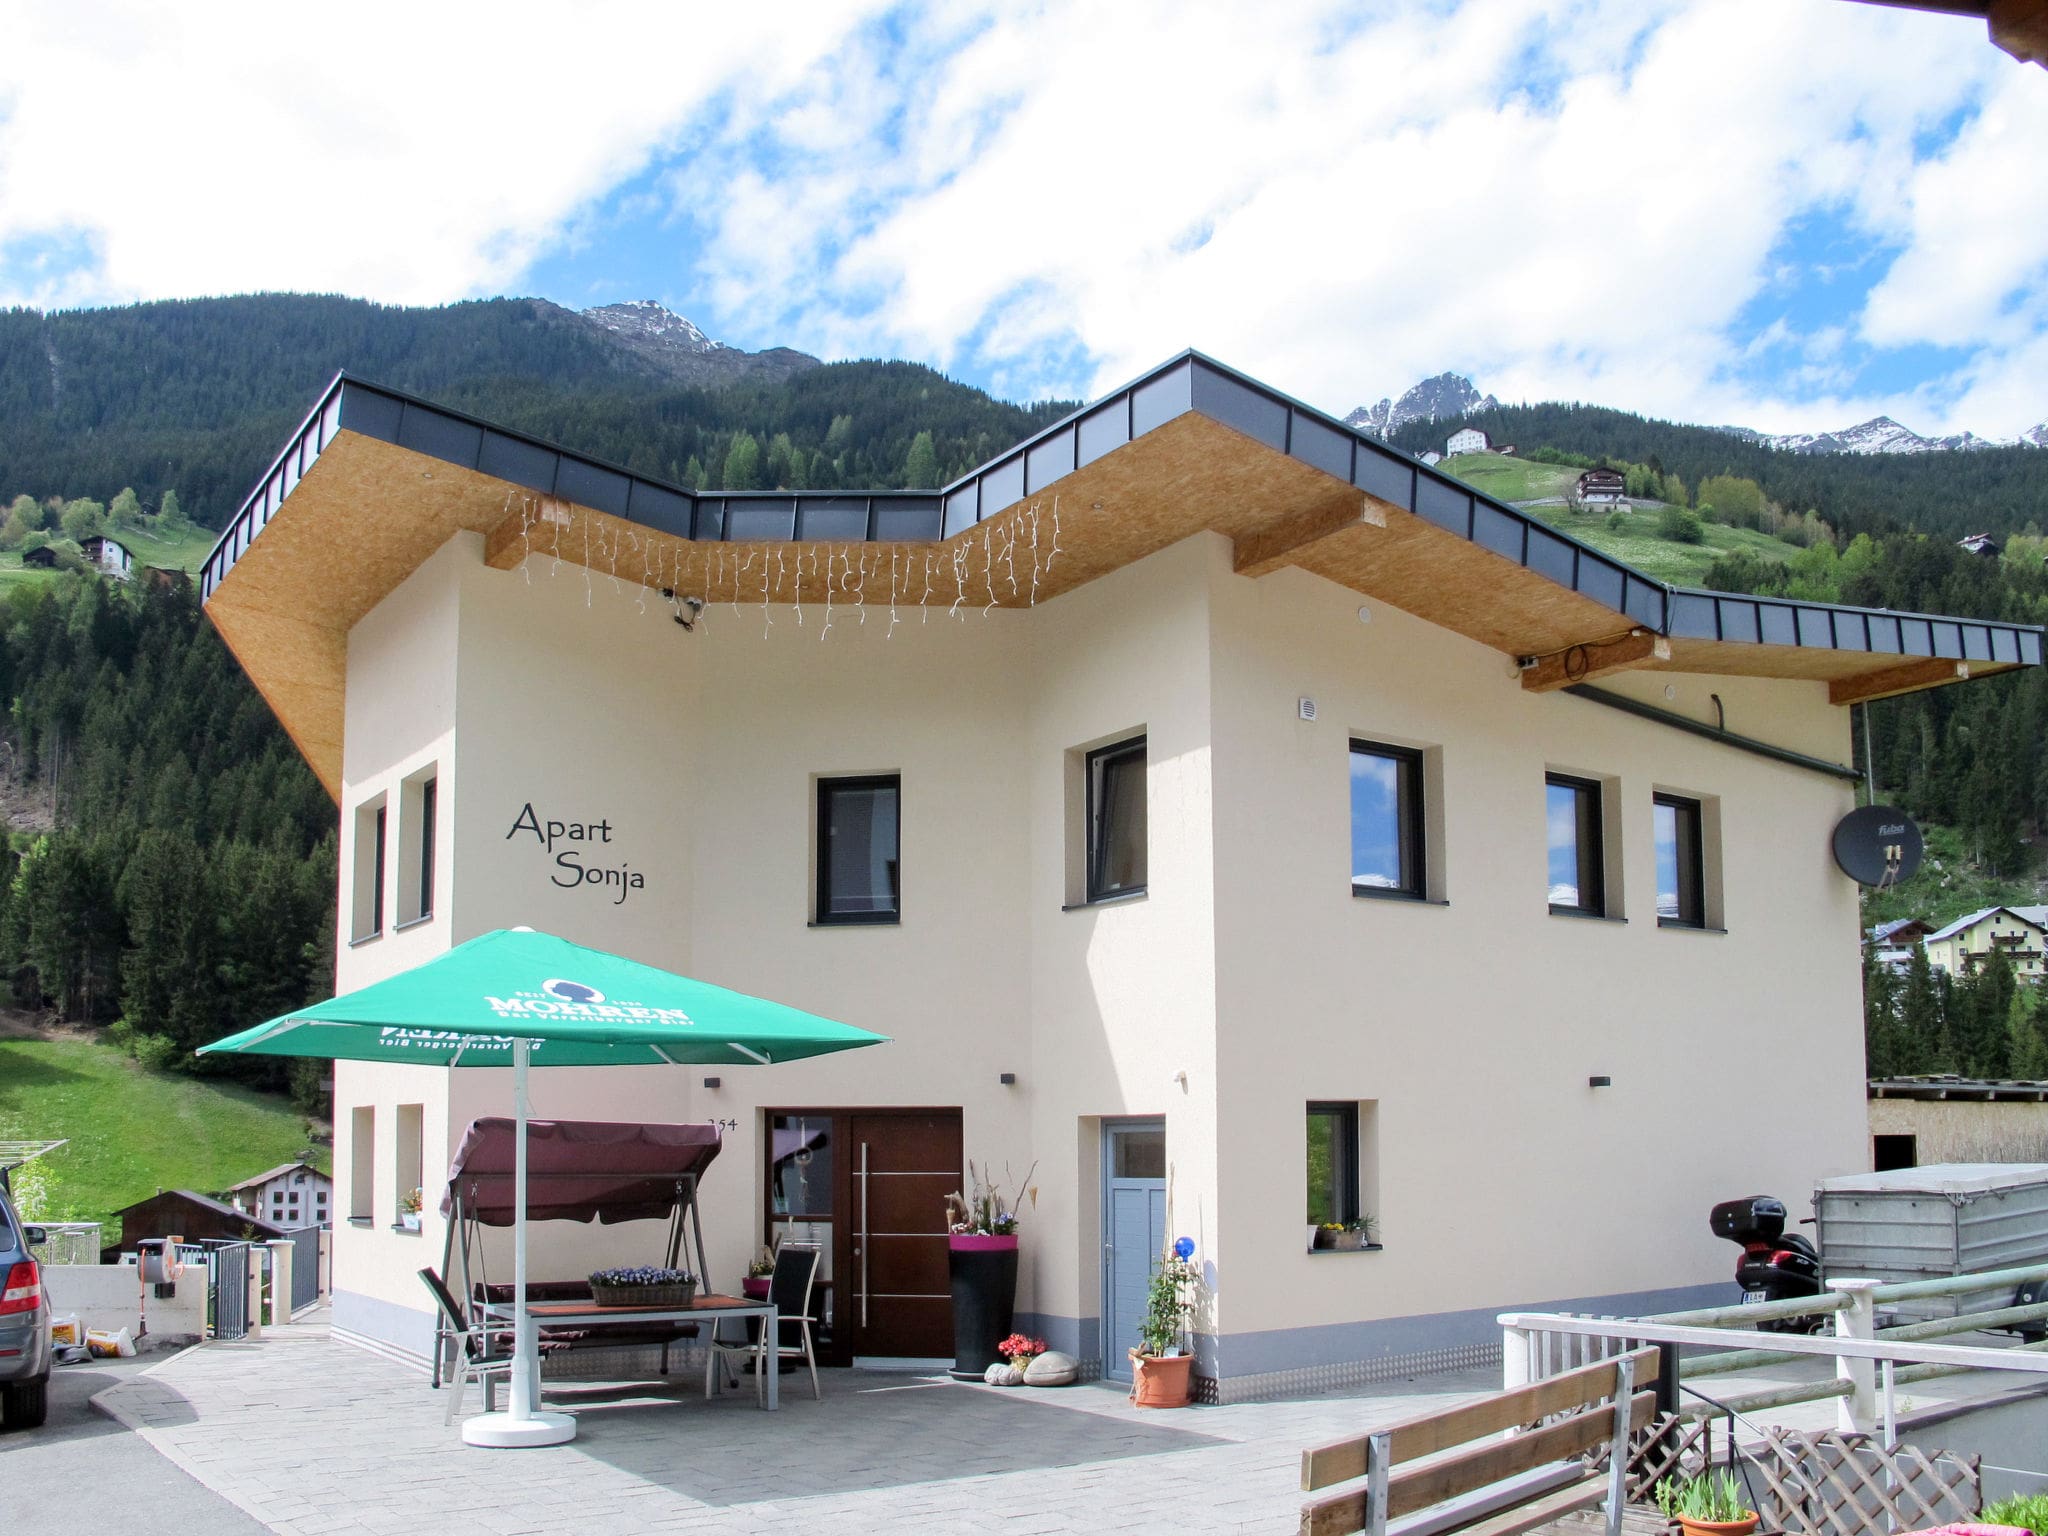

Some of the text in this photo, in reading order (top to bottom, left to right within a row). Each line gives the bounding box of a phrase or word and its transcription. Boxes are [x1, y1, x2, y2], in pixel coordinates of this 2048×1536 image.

[505, 802, 613, 853] Apart
[1878, 824, 1905, 835] fuba
[551, 851, 645, 905] Sonja
[483, 996, 690, 1020] MOHREN
[497, 1010, 532, 1019] Das
[536, 1013, 651, 1025] Vorarlberger
